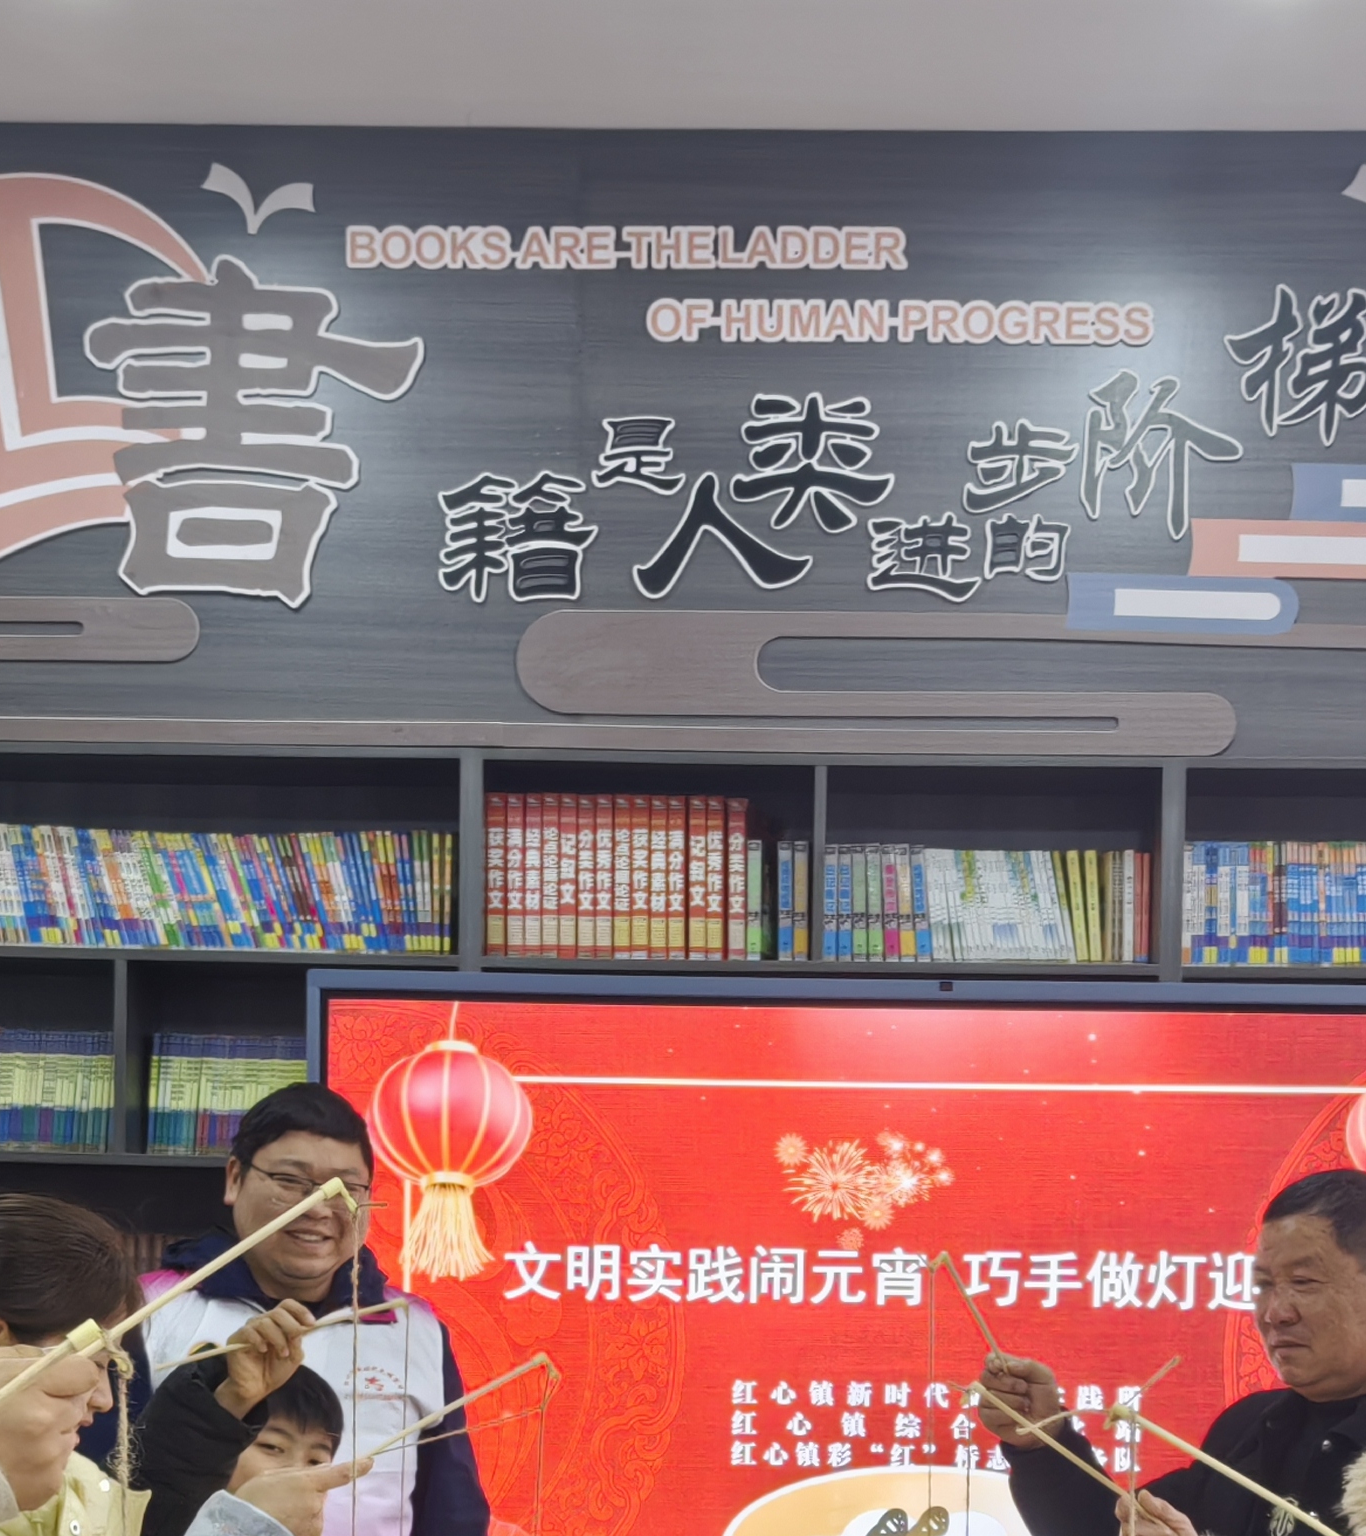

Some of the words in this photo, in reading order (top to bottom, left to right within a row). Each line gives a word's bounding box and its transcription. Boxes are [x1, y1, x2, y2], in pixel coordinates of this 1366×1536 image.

[346, 226, 511, 270] BOOKS
[519, 226, 616, 270] ARE
[647, 297, 711, 343] OF
[720, 299, 891, 344] HUMAN
[897, 301, 1154, 346] PROGRESS
[503, 1242, 924, 1306] 文明实践闹元宵
[965, 1249, 1258, 1311] 巧手做灯迎
[730, 1411, 1142, 1443] 红心镇综合站
